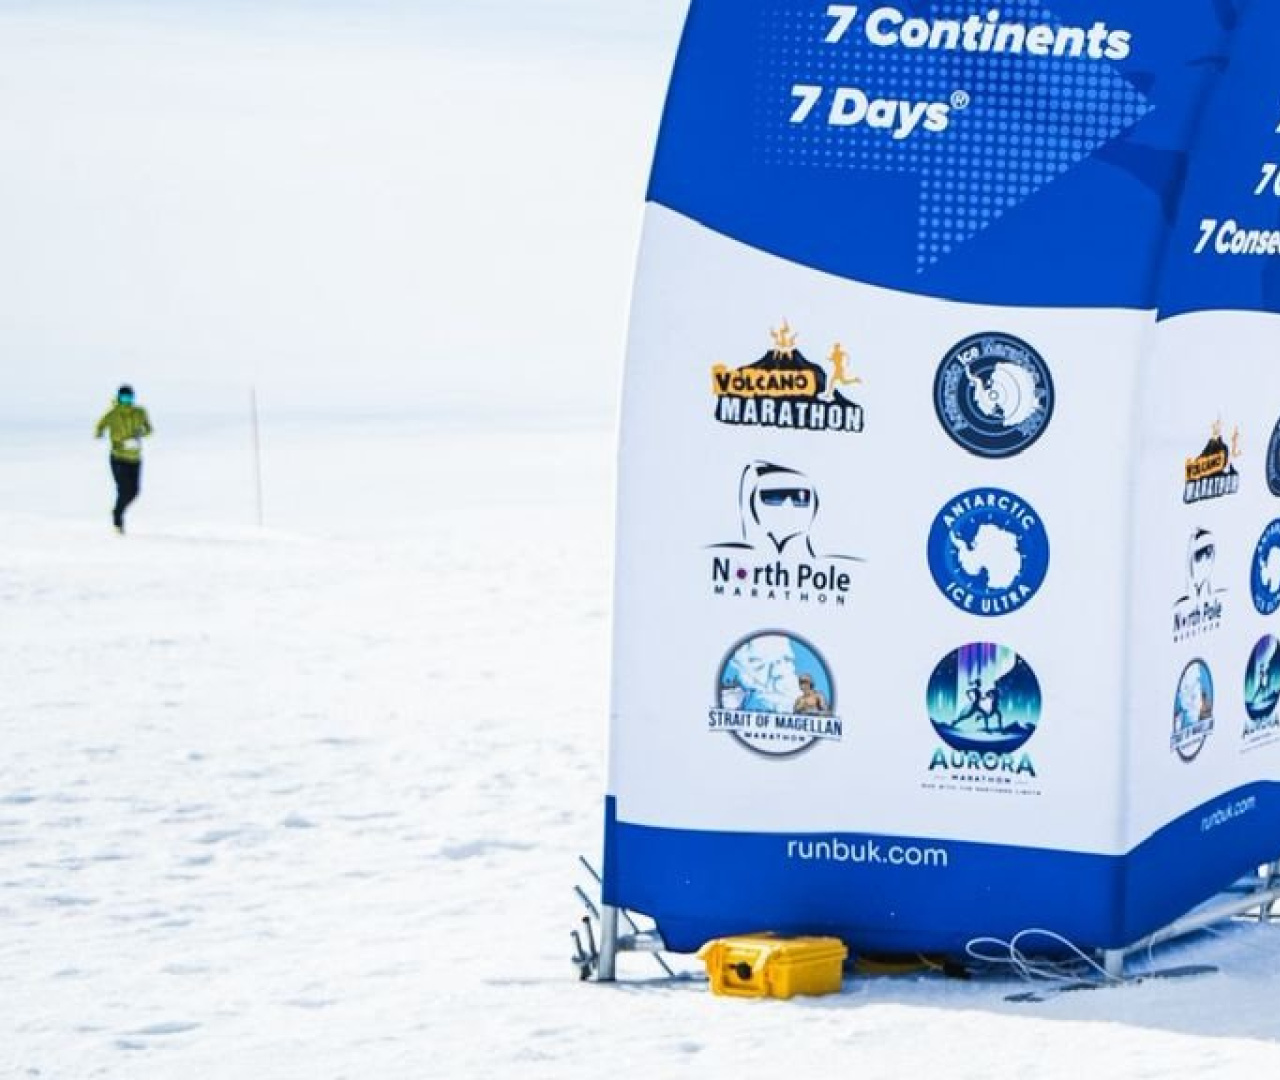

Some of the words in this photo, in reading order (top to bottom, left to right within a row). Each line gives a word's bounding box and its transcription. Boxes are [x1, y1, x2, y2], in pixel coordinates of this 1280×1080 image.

[824, 4, 858, 43] 7
[865, 6, 1132, 60] Continents
[788, 84, 822, 124] 7
[1254, 163, 1278, 195] 7
[1193, 219, 1217, 254] 7
[714, 371, 809, 391] VOLCANO
[720, 396, 862, 432] MARATHON
[943, 493, 1036, 531] ANTARCTIC
[797, 563, 851, 592] Pole
[713, 585, 845, 605] MARATHON
[946, 582, 975, 608] ICE
[981, 584, 1031, 612] ULTRA
[708, 710, 751, 727] STRAIT
[755, 713, 770, 728] OF
[775, 716, 842, 735] MAGELLAN
[928, 747, 1037, 778] AURORA
[786, 839, 949, 867] runbuk.com
